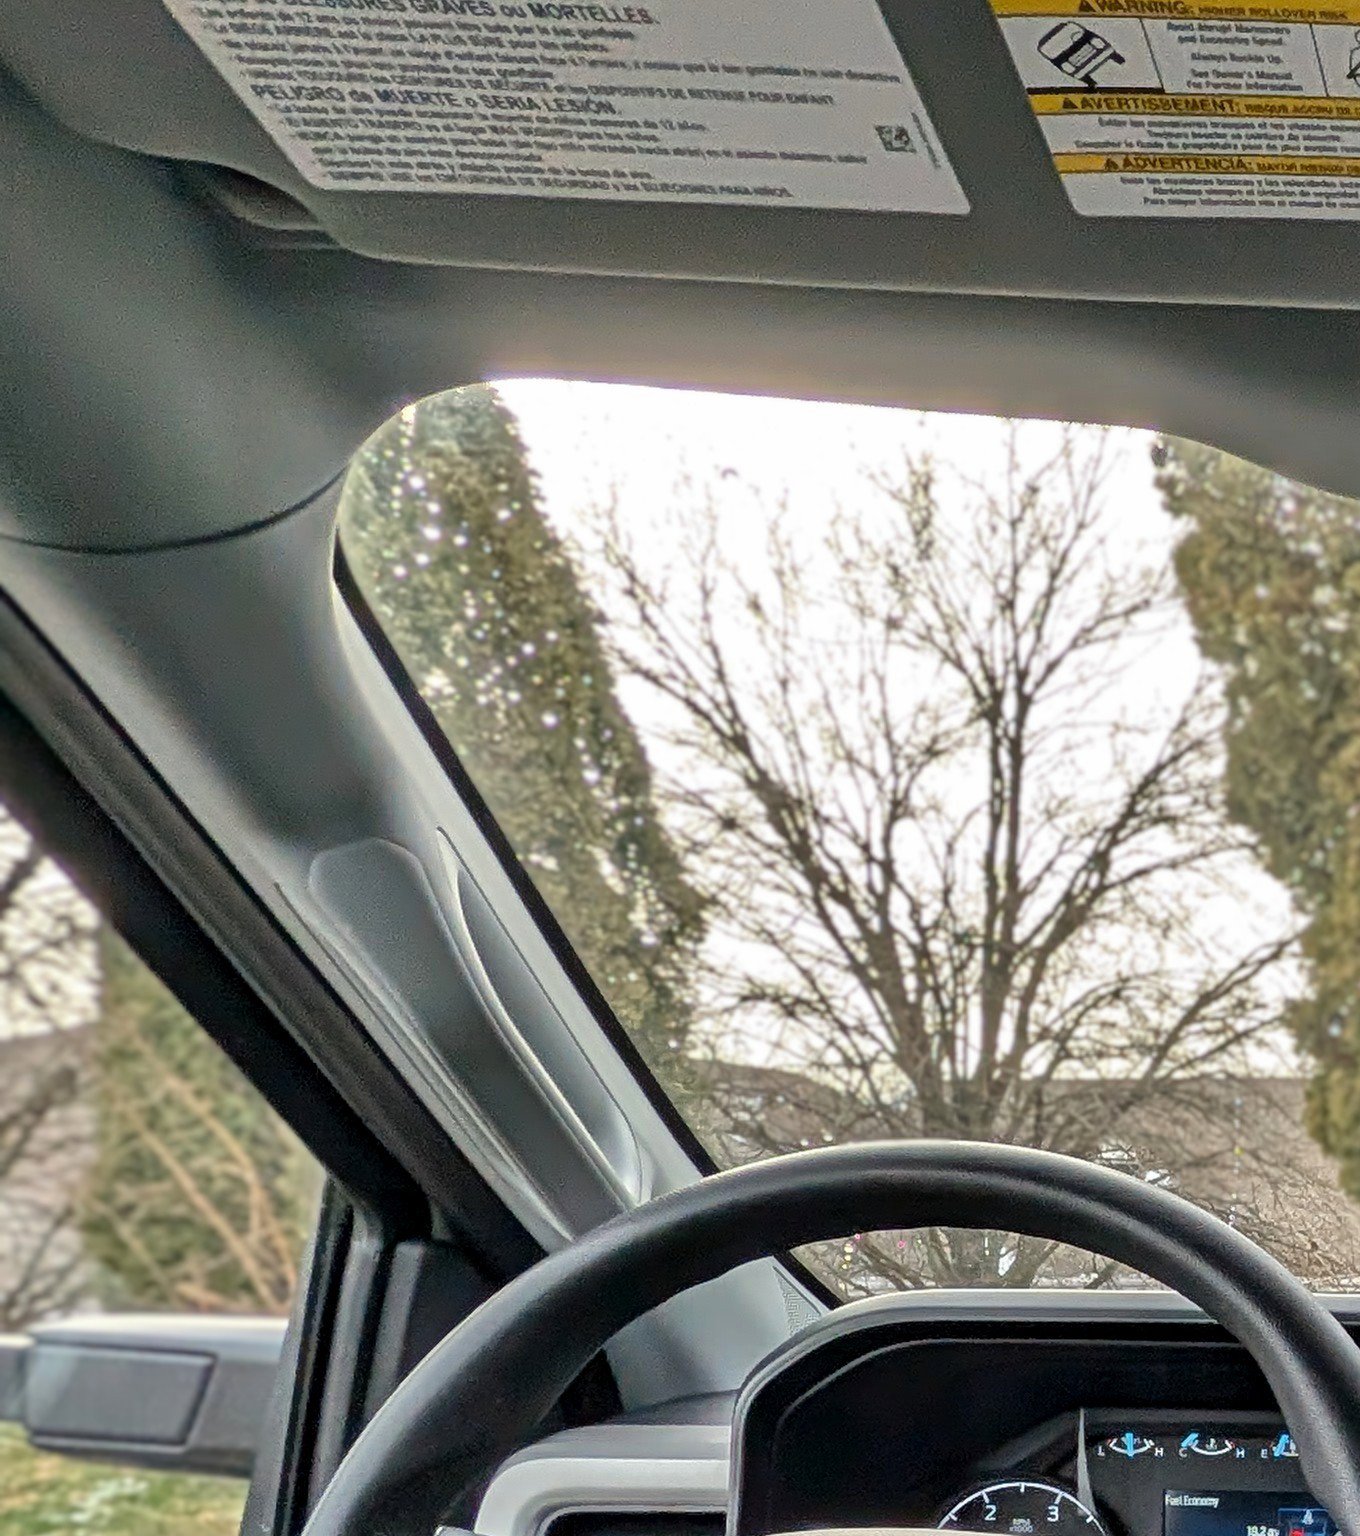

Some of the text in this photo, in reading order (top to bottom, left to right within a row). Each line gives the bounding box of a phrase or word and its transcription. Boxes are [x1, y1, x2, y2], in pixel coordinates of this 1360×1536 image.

[250, 84, 344, 101] PELIGRO
[1154, 1446, 1164, 1458] H
[1235, 1447, 1245, 1459] H
[984, 1504, 997, 1521] 2
[1047, 1504, 1060, 1522] 3
